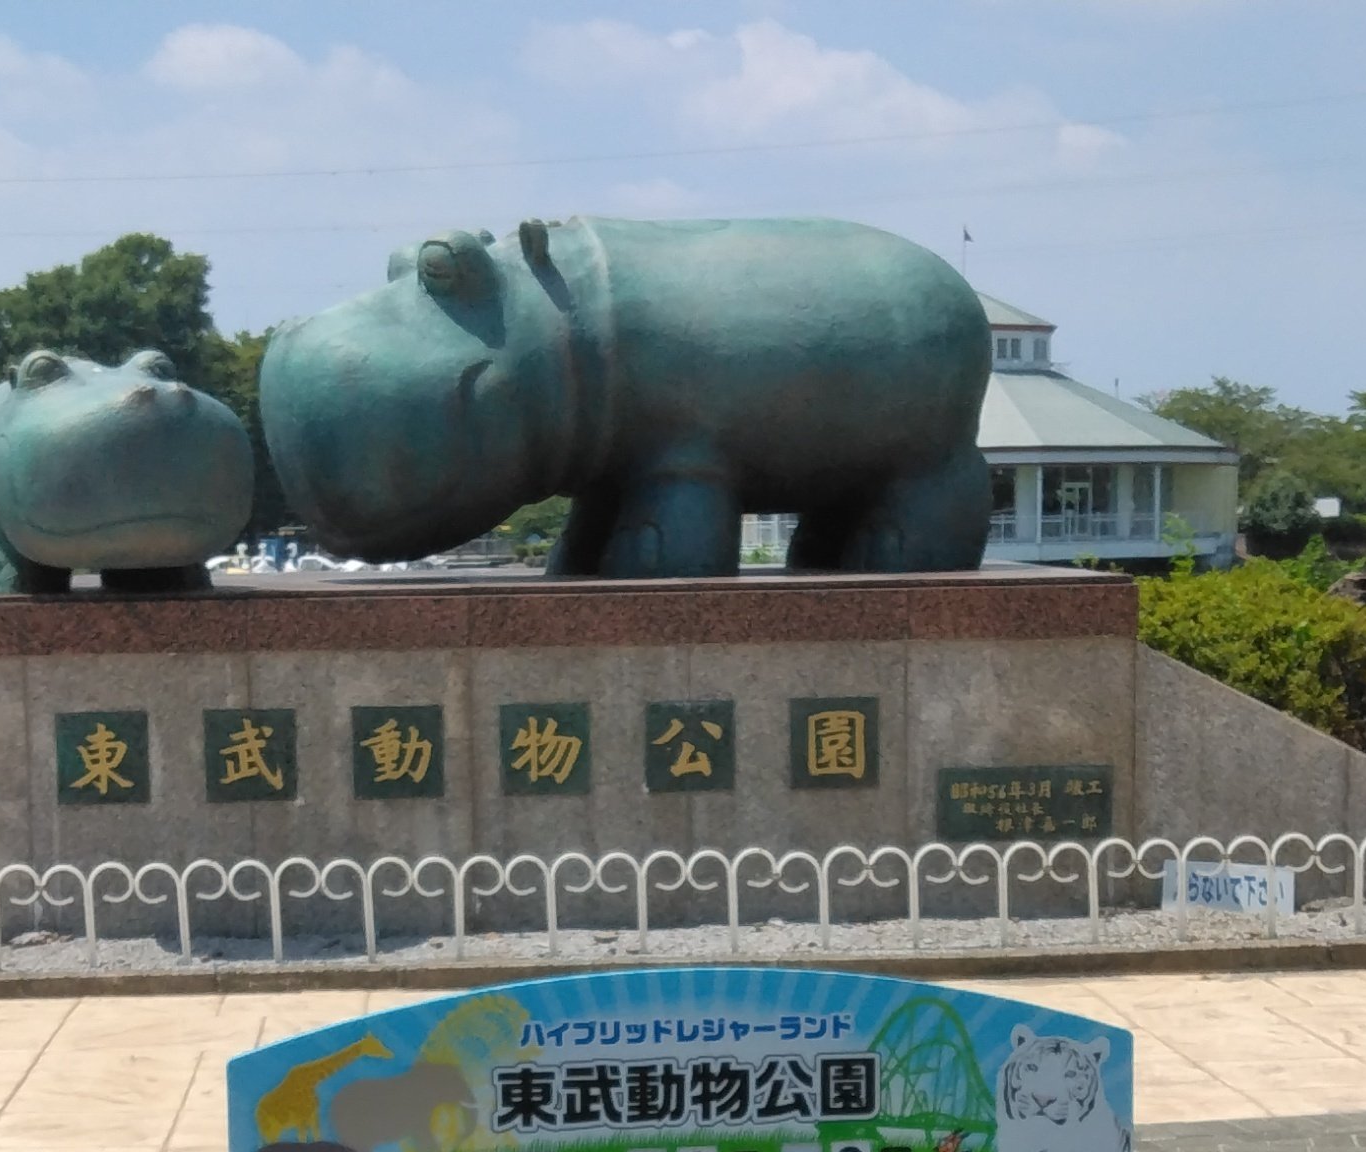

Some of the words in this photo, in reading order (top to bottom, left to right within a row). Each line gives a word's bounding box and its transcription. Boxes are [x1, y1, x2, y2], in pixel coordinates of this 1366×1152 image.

[68, 710, 865, 794] 東武動物公園
[521, 1014, 855, 1047] ハイブリッドレジャーランド
[497, 1057, 877, 1128] 東武動物公園
